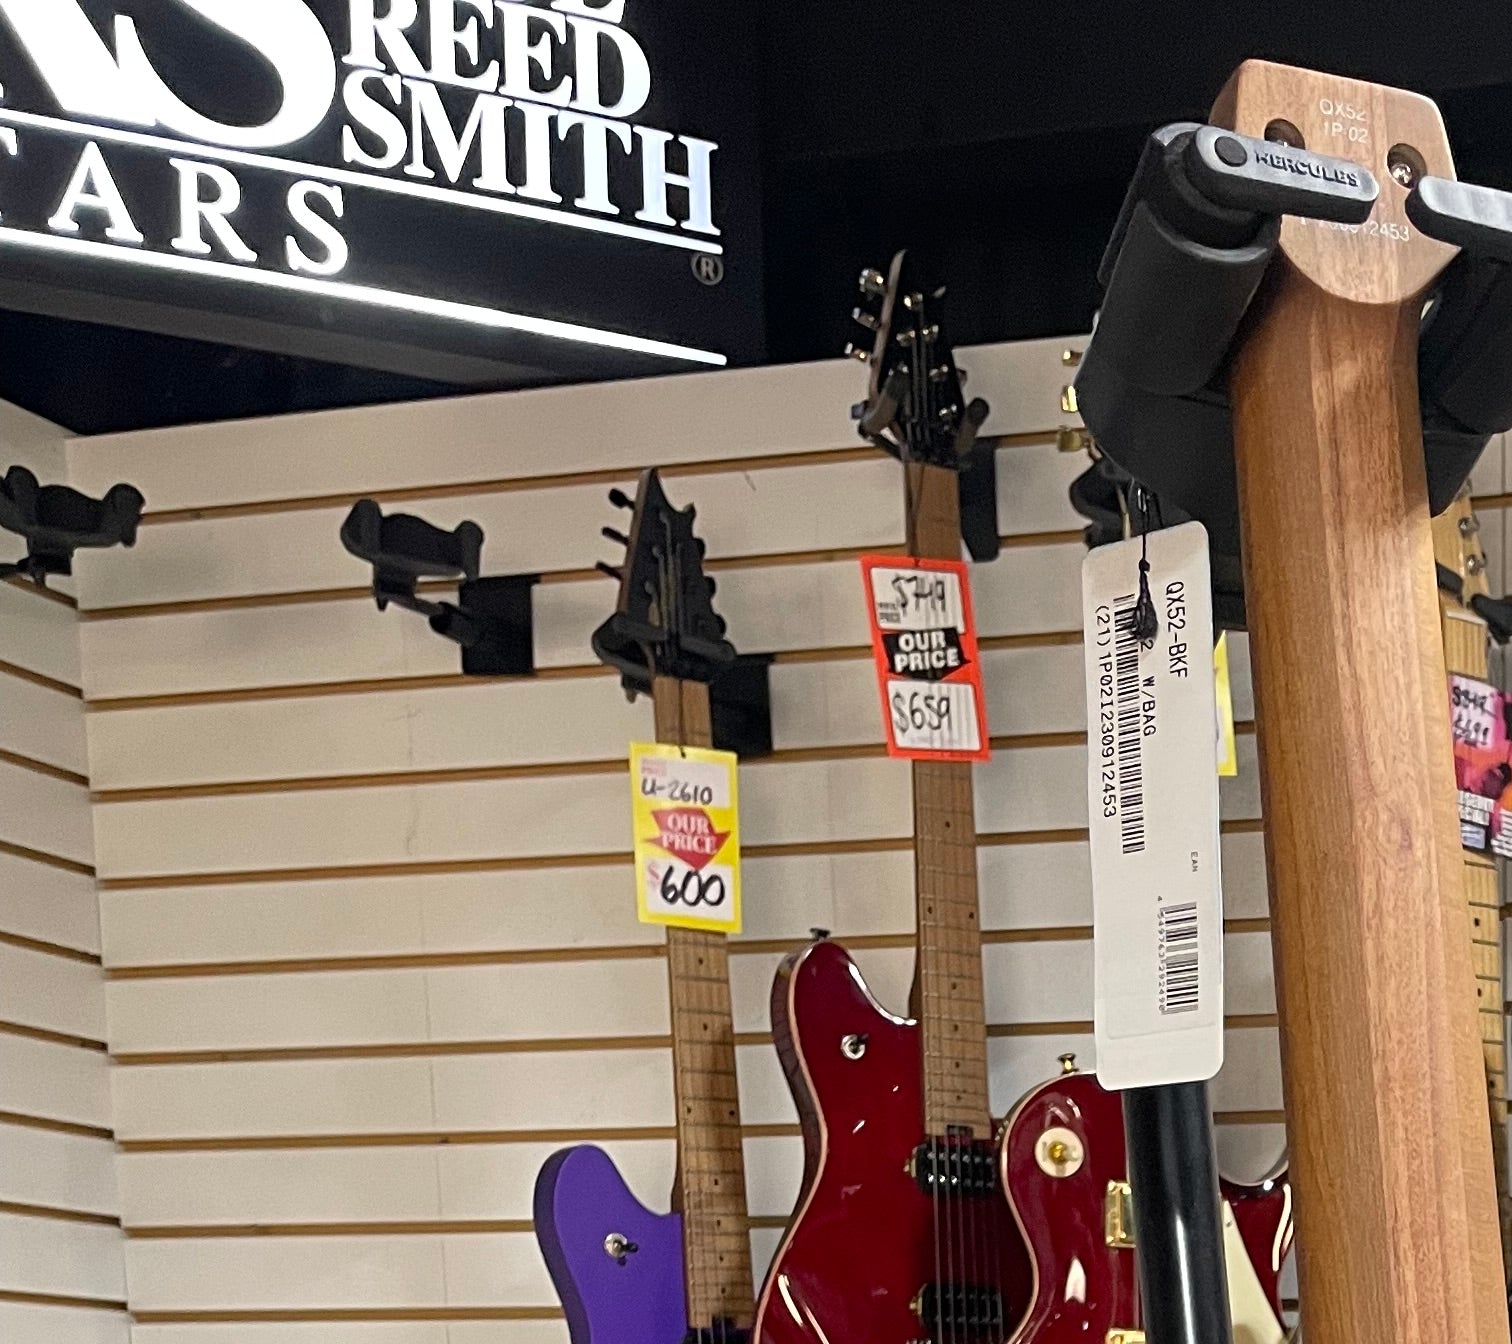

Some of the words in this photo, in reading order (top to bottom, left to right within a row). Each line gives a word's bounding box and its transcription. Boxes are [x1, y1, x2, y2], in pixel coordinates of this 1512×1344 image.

[340, 0, 651, 118] REED
[340, 67, 721, 237] SMITH
[1254, 150, 1359, 188] HERCULES
[898, 630, 947, 653] OUR
[1165, 580, 1189, 680] QX52-BKF
[893, 647, 960, 673] PRICE
[892, 690, 951, 736] $659
[1141, 675, 1158, 737] W/BAG
[660, 832, 719, 855] PRICE
[667, 813, 711, 835] OUR
